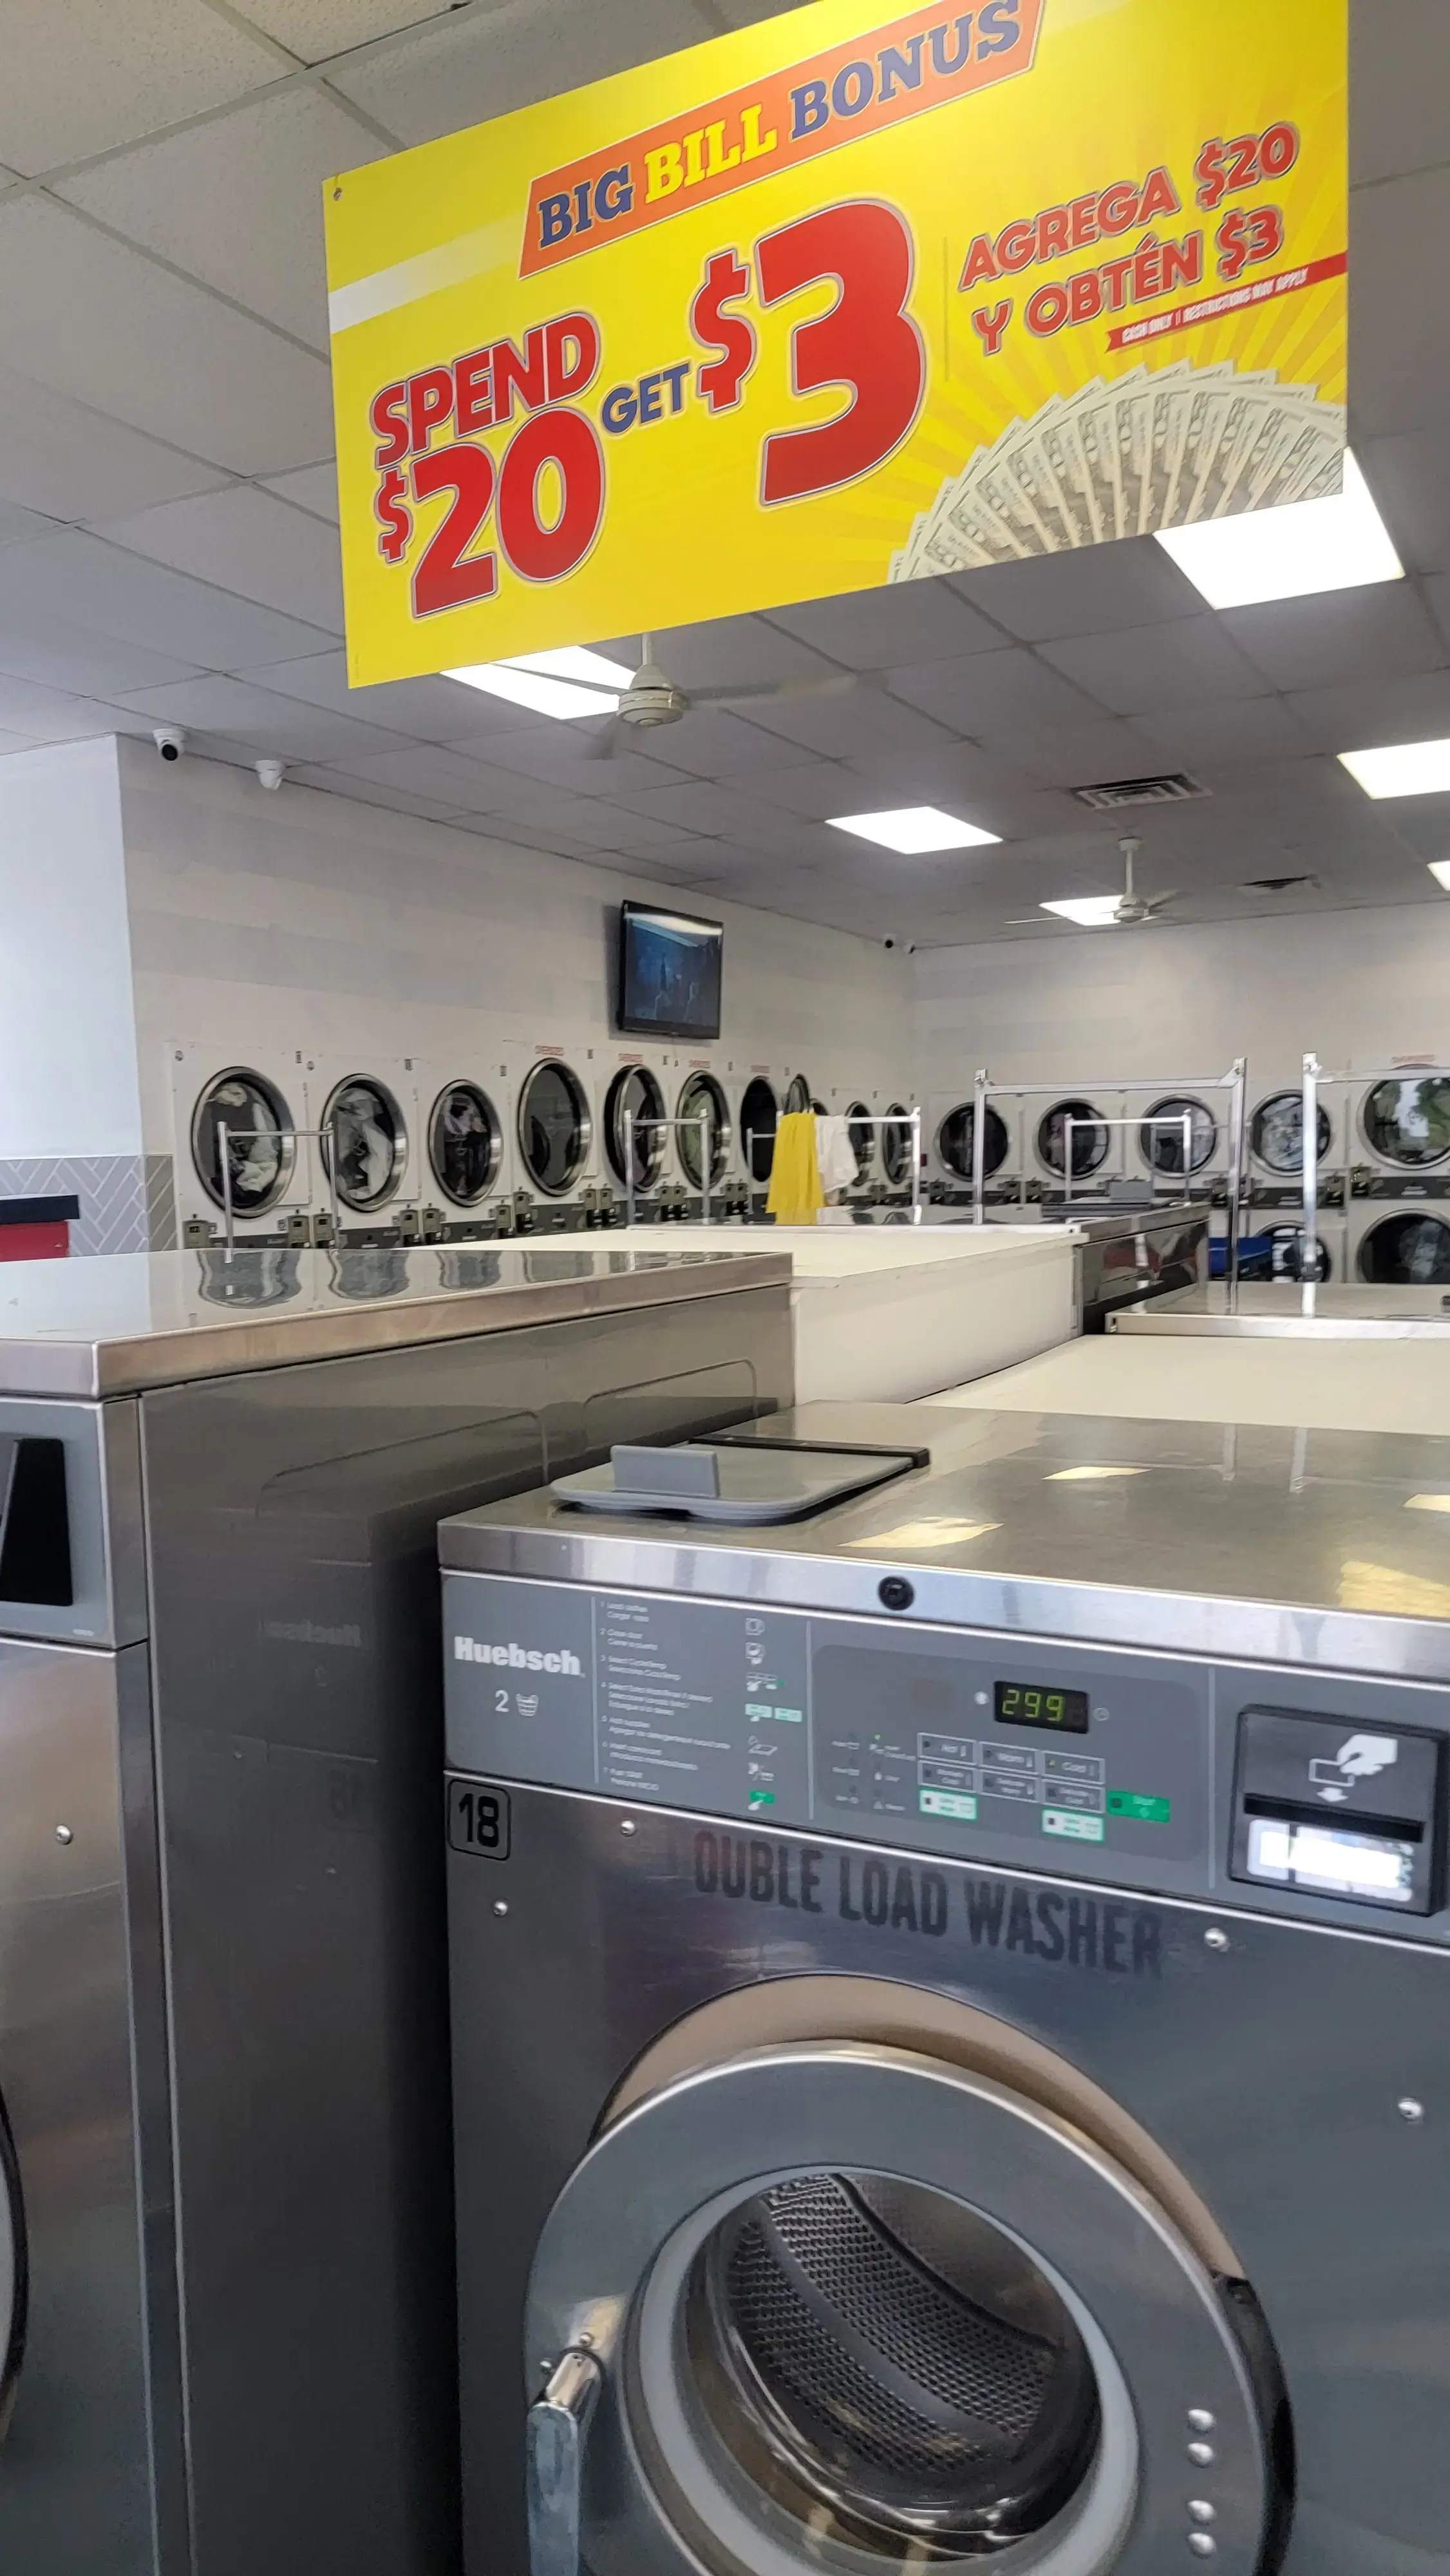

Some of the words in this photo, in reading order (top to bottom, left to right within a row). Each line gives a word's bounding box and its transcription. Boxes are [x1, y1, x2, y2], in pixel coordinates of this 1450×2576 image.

[538, 162, 634, 249] BIG
[645, 104, 777, 204] BILL
[791, 0, 1021, 139] BONUS
[959, 167, 1181, 291] AGREGA
[1193, 122, 1299, 211] $20
[972, 299, 1013, 355] Y
[1025, 231, 1203, 337] OBTÉN
[1216, 205, 1284, 281] $3
[371, 312, 600, 469] SPEND
[602, 362, 691, 434] GET
[689, 198, 927, 505] $3
[375, 408, 605, 618] $20
[455, 1636, 581, 1676] Huebsch
[494, 1689, 509, 1712] 2
[458, 1792, 500, 1848] 18
[838, 1856, 948, 1937] LOAD
[965, 1879, 1162, 1980] WASHER
